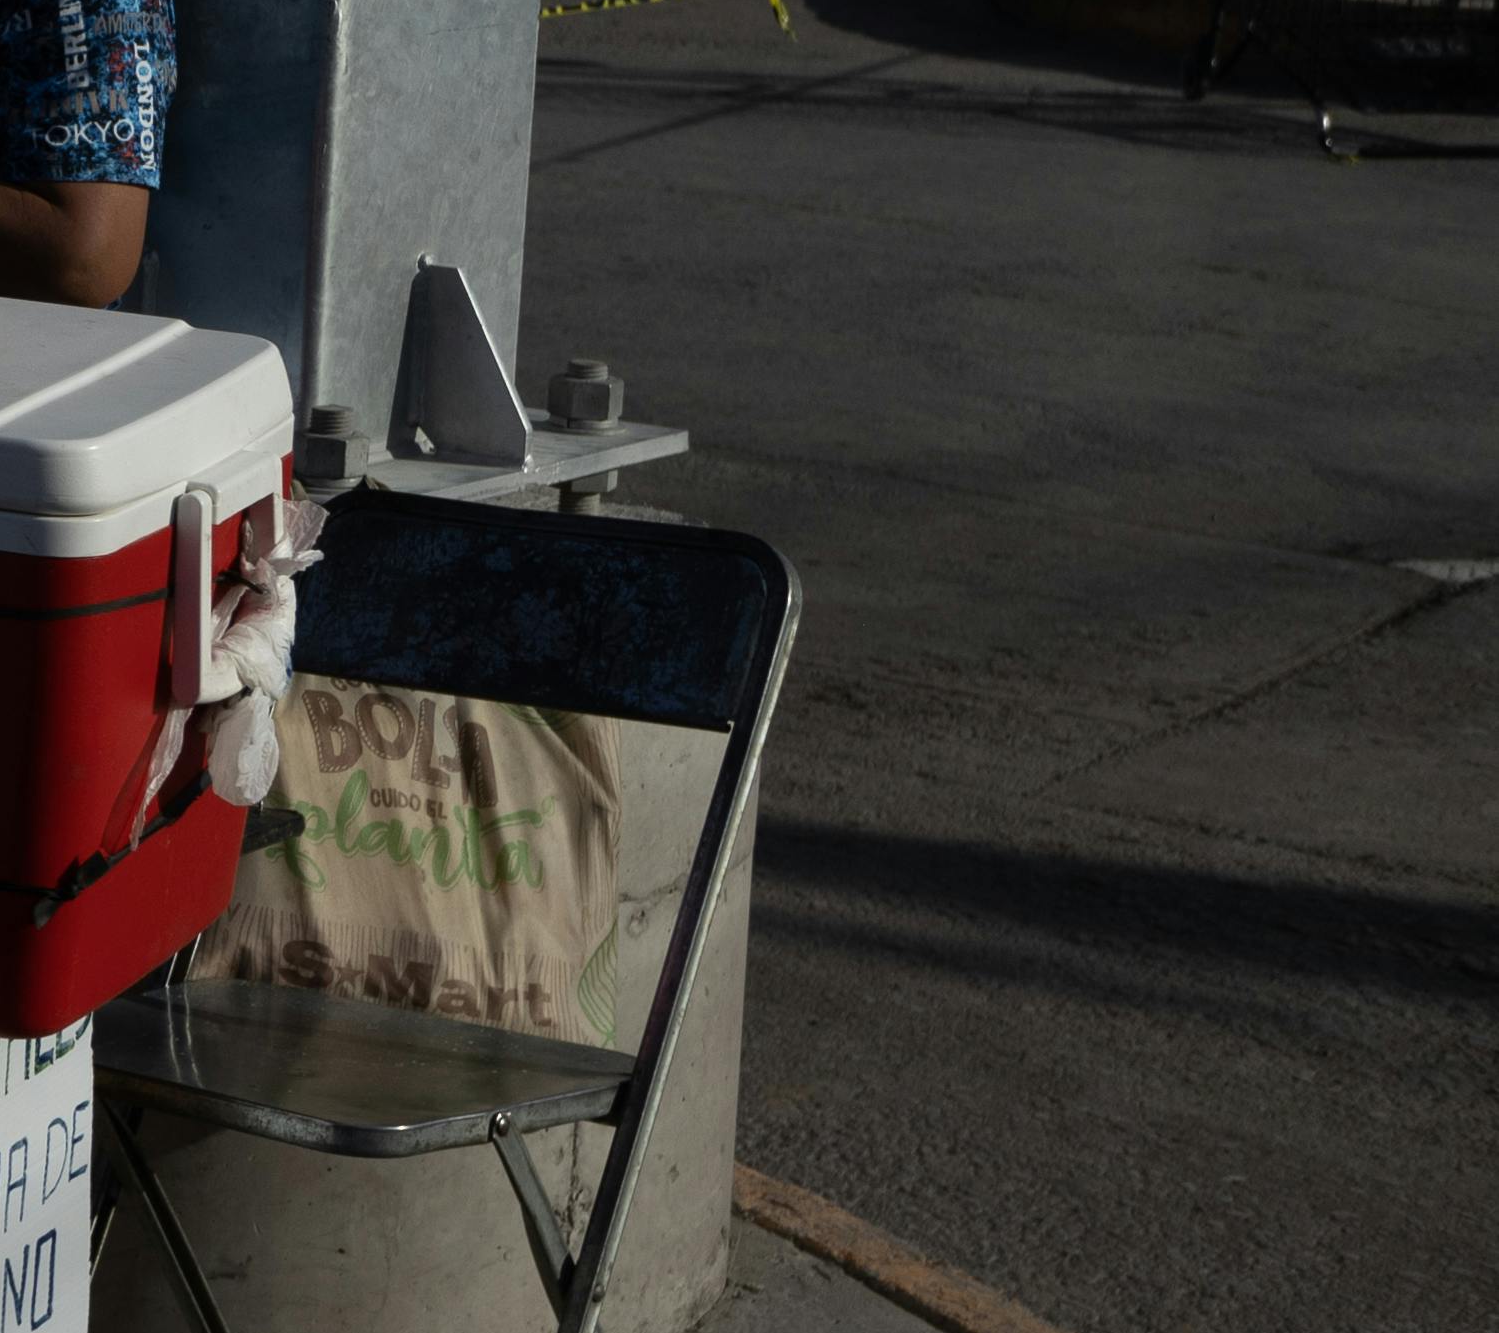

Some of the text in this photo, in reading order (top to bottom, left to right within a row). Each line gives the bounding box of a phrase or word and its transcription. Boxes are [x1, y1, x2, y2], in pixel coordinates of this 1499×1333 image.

[31, 118, 135, 150] TOKYO
[133, 37, 156, 171] LONDON
[41, 1099, 91, 1206] DE
